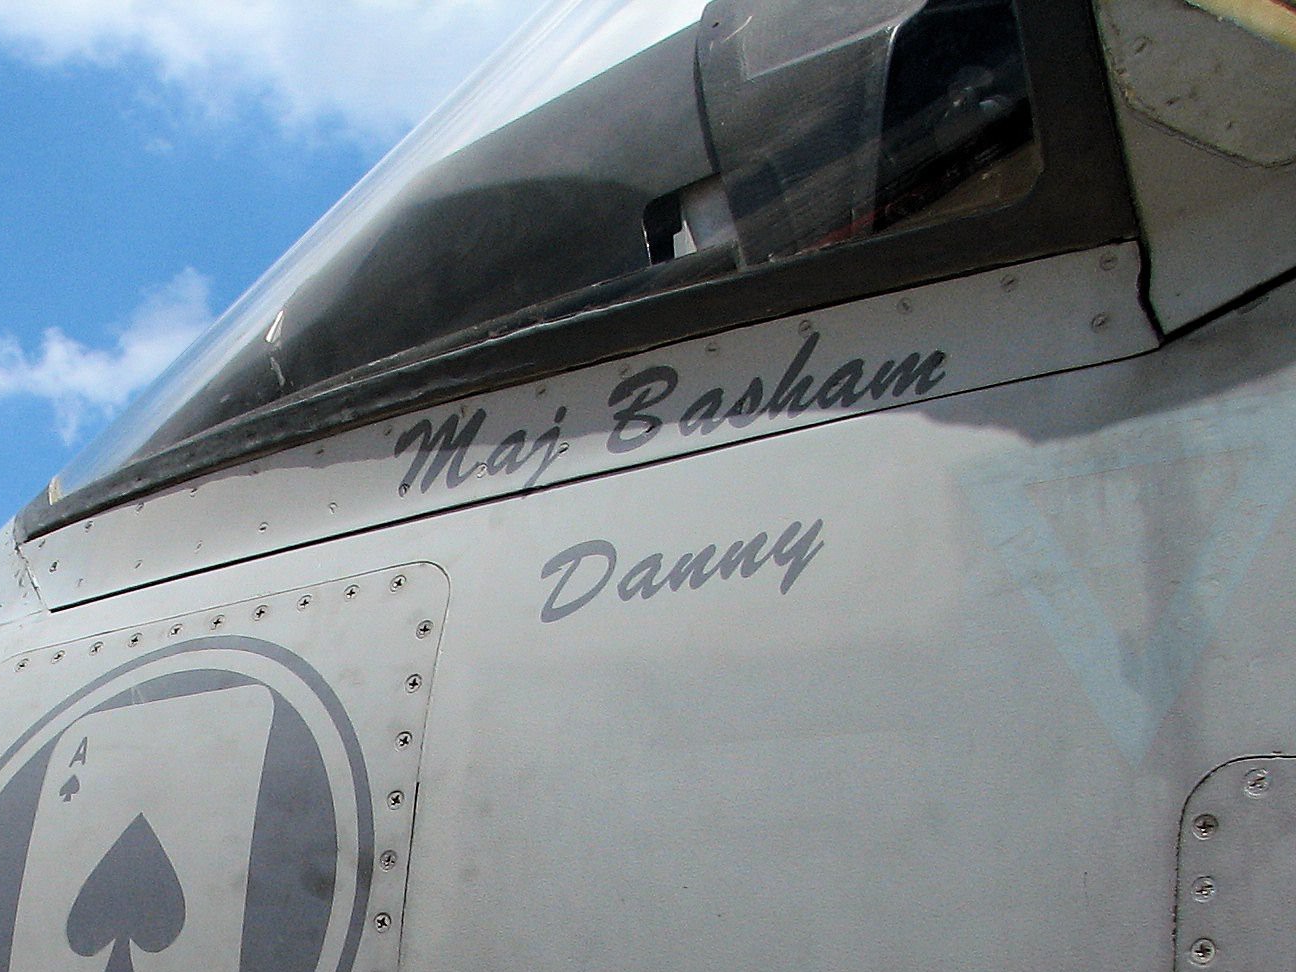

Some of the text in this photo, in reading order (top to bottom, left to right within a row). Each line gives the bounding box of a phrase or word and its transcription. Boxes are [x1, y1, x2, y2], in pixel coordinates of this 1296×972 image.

[394, 332, 947, 499] Maj Basham
[540, 518, 825, 624] Danny
[68, 736, 89, 768] A
